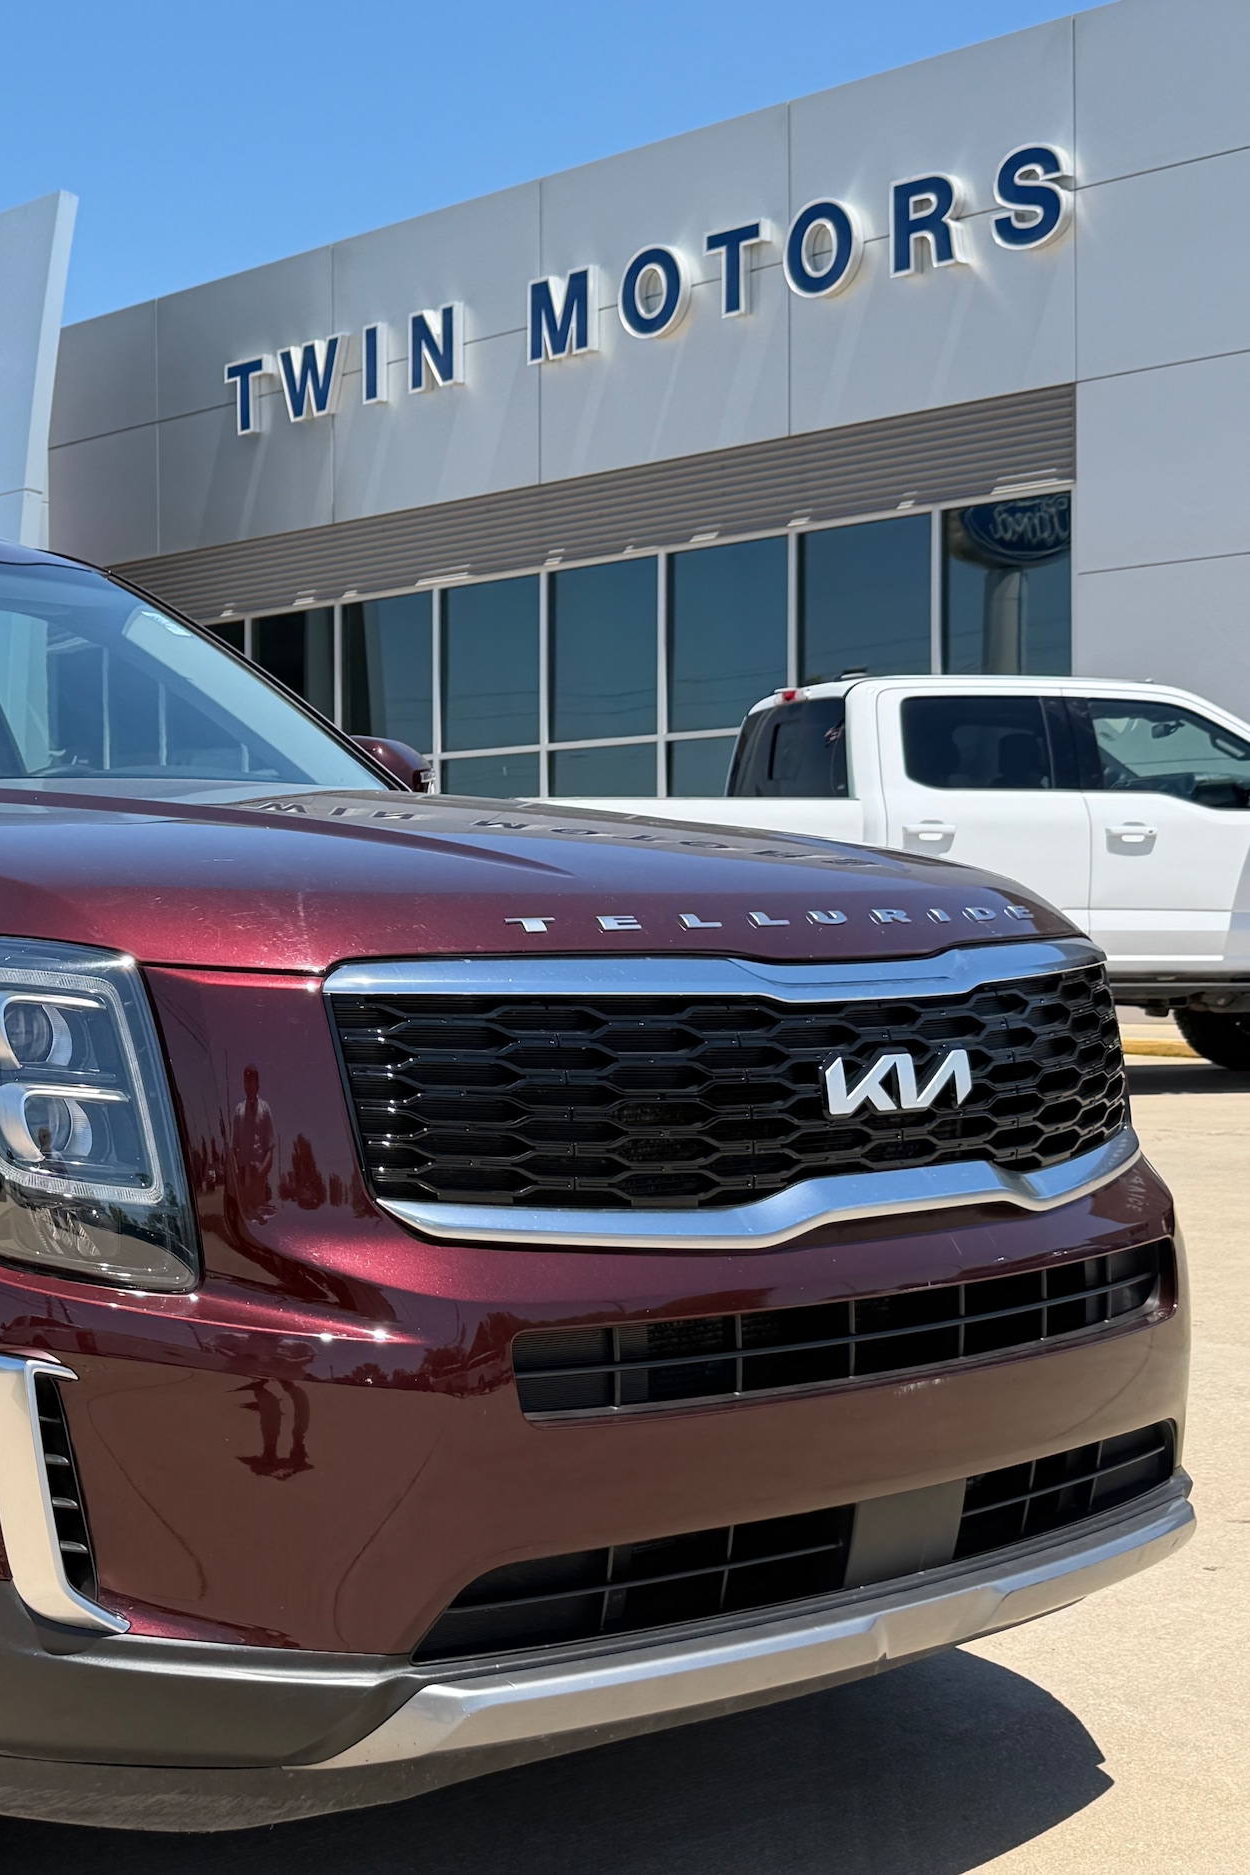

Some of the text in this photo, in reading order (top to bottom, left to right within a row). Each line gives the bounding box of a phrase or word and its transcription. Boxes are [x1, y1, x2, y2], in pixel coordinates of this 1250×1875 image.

[224, 143, 1073, 435] TWIN MOTORS
[504, 905, 1036, 934] TELLURIDE
